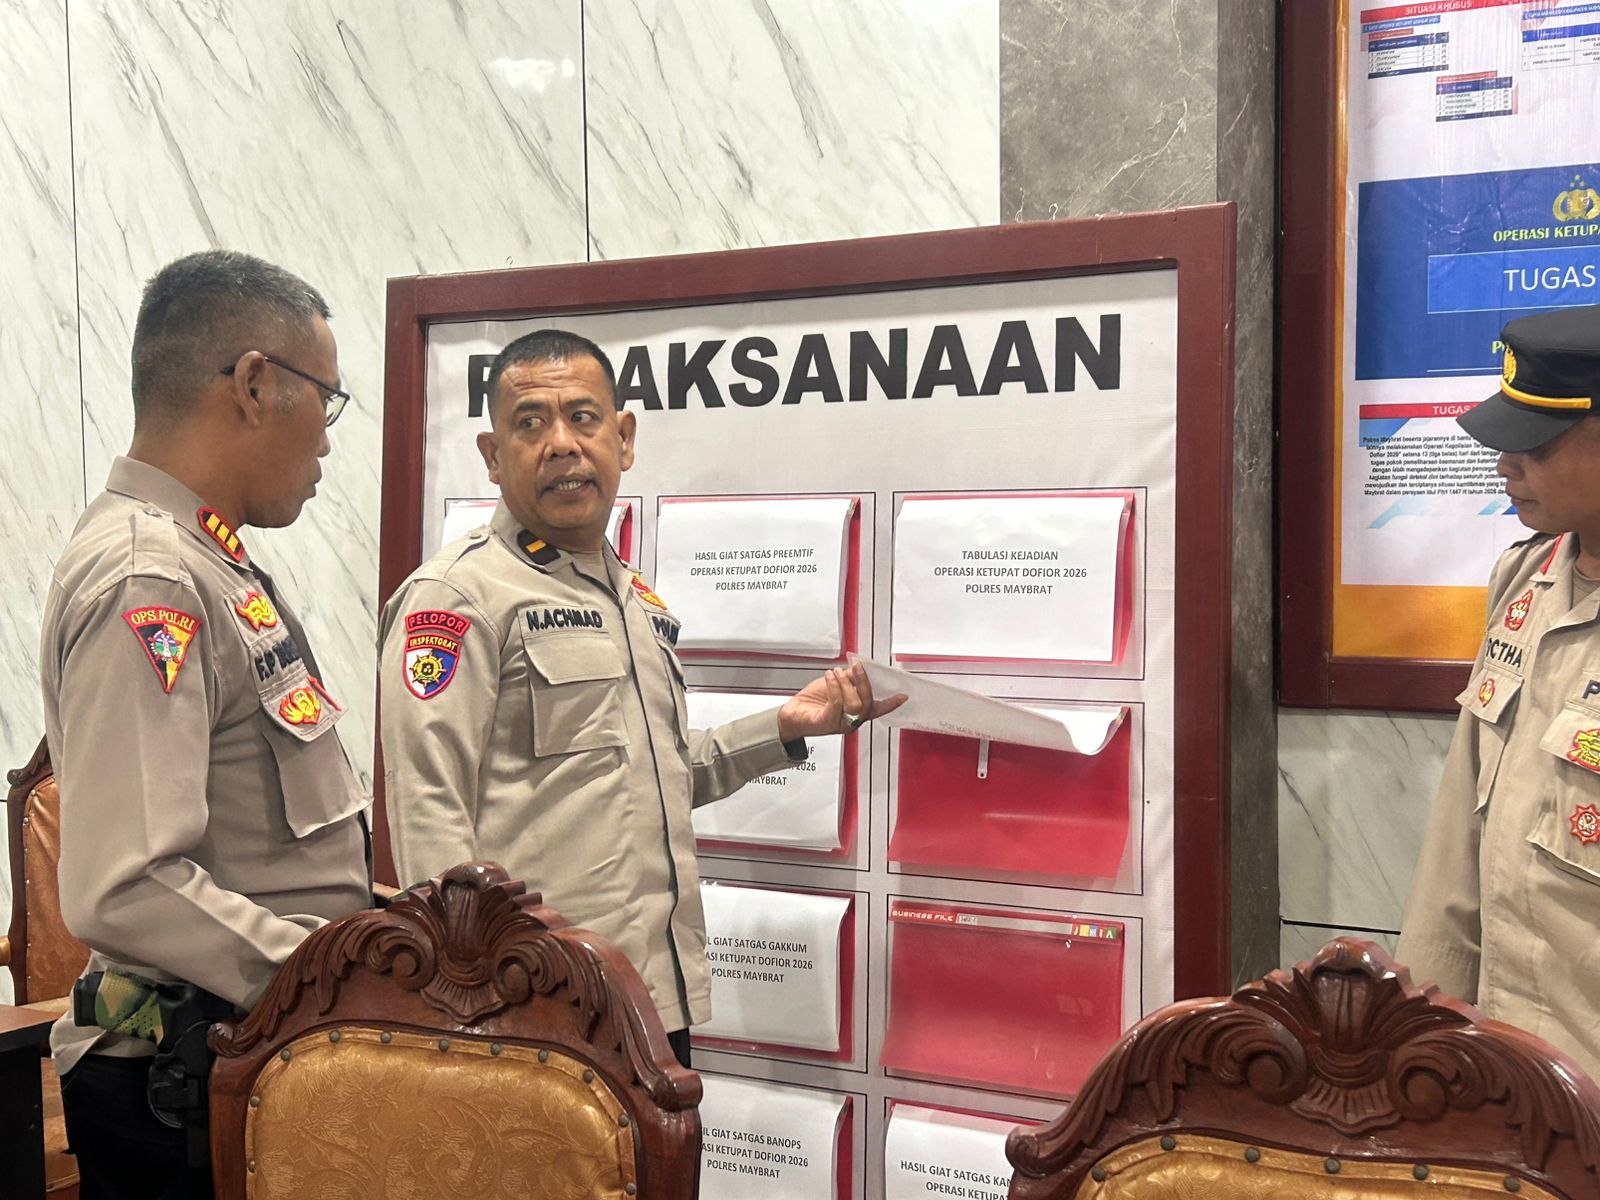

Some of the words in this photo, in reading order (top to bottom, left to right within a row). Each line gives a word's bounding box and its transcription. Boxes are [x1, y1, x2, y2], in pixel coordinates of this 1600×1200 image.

[1493, 227, 1550, 242] OPERASI
[1554, 224, 1600, 238] KETUP
[1503, 264, 1596, 292] TUGAS
[695, 551, 718, 561] HASIL
[719, 551, 738, 560] GIAT
[740, 550, 771, 559] SATGAS
[773, 548, 814, 558] PREEMTIF
[962, 550, 1008, 560] TABULASI
[1010, 551, 1058, 560] KEJADIAN
[690, 566, 724, 576] OPERASI
[725, 565, 762, 575] KETUPAT
[763, 565, 795, 574] DOFIOR
[797, 564, 817, 573] 2026
[934, 567, 974, 577] OPERASI
[976, 567, 1020, 577] KETUPAT
[1022, 568, 1061, 577] DOFIOR
[1063, 568, 1087, 578] 2026
[715, 581, 745, 591] POLRES
[747, 580, 788, 590] MAYBRAT
[965, 584, 1001, 593] POLRES
[1003, 584, 1053, 594] MAYBRAT
[158, 609, 196, 632] POLRI
[408, 613, 465, 632] PELOPOR
[526, 608, 603, 632] N.ACHMAD
[409, 636, 458, 651] INSPEKTORAT
[713, 937, 733, 947] GIAT
[734, 938, 767, 949] SATGAS
[768, 941, 807, 953] GAKKUM
[719, 952, 756, 965] KETUPAT
[758, 956, 791, 968] DOFIOR
[792, 959, 813, 969] 2026
[711, 967, 741, 979] POLRES
[743, 971, 784, 983] MAYBRAT
[711, 1128, 731, 1139] GIAT
[732, 1131, 764, 1144] SATGAS
[766, 1136, 801, 1150] BANOPS
[715, 1144, 752, 1159] KETUPAT
[754, 1150, 787, 1164] DOFIOR
[788, 1155, 809, 1167] 2026
[707, 1159, 737, 1172] POLRES
[739, 1164, 780, 1179] MAYBRAT
[900, 1160, 927, 1173] HASIL
[929, 1165, 951, 1178] GIAT
[953, 1169, 991, 1184] SATGAS
[926, 1181, 965, 1197] OPERASI
[968, 1188, 1009, 1200] KETUPA
